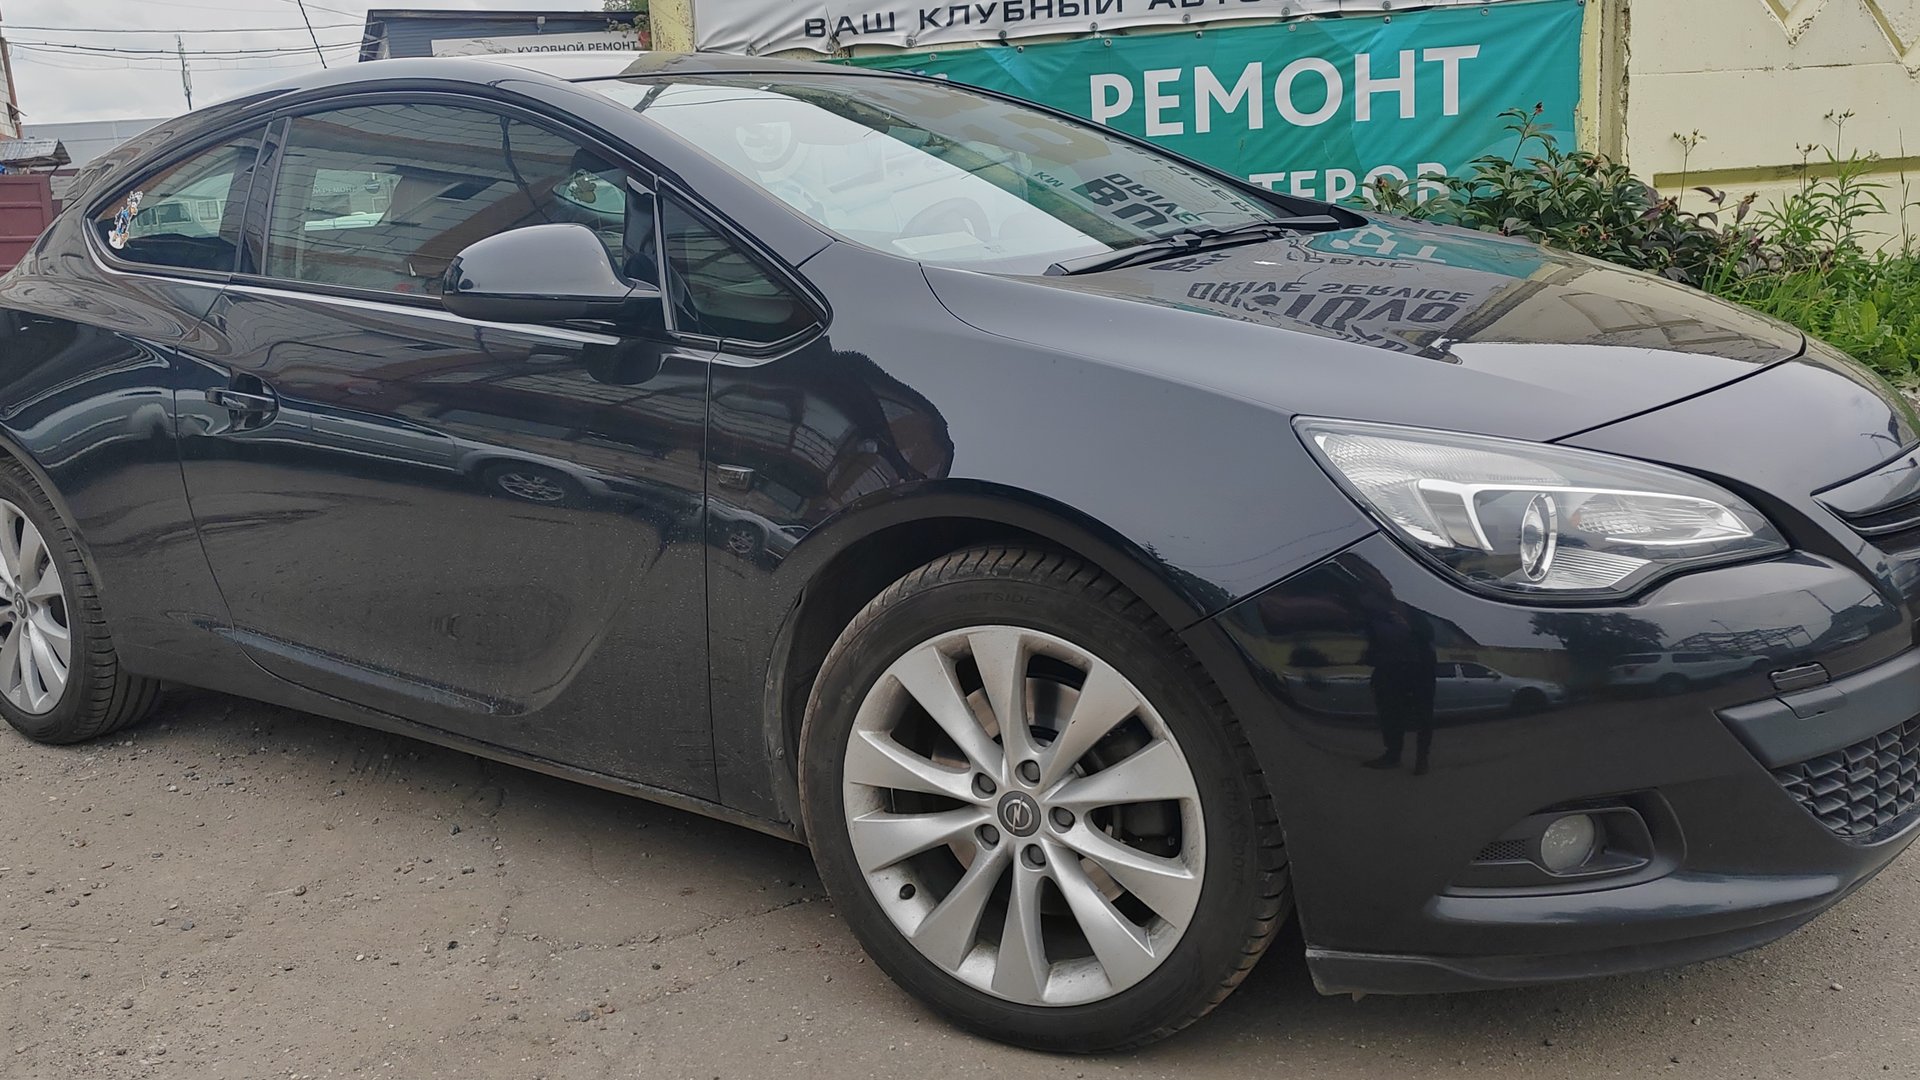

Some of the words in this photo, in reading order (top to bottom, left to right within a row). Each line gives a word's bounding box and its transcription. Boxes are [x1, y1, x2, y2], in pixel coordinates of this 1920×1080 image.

[804, 11, 895, 37] ВАШ
[588, 40, 637, 51] РЕМОНТ
[1090, 44, 1481, 137] РЕМОНТ
